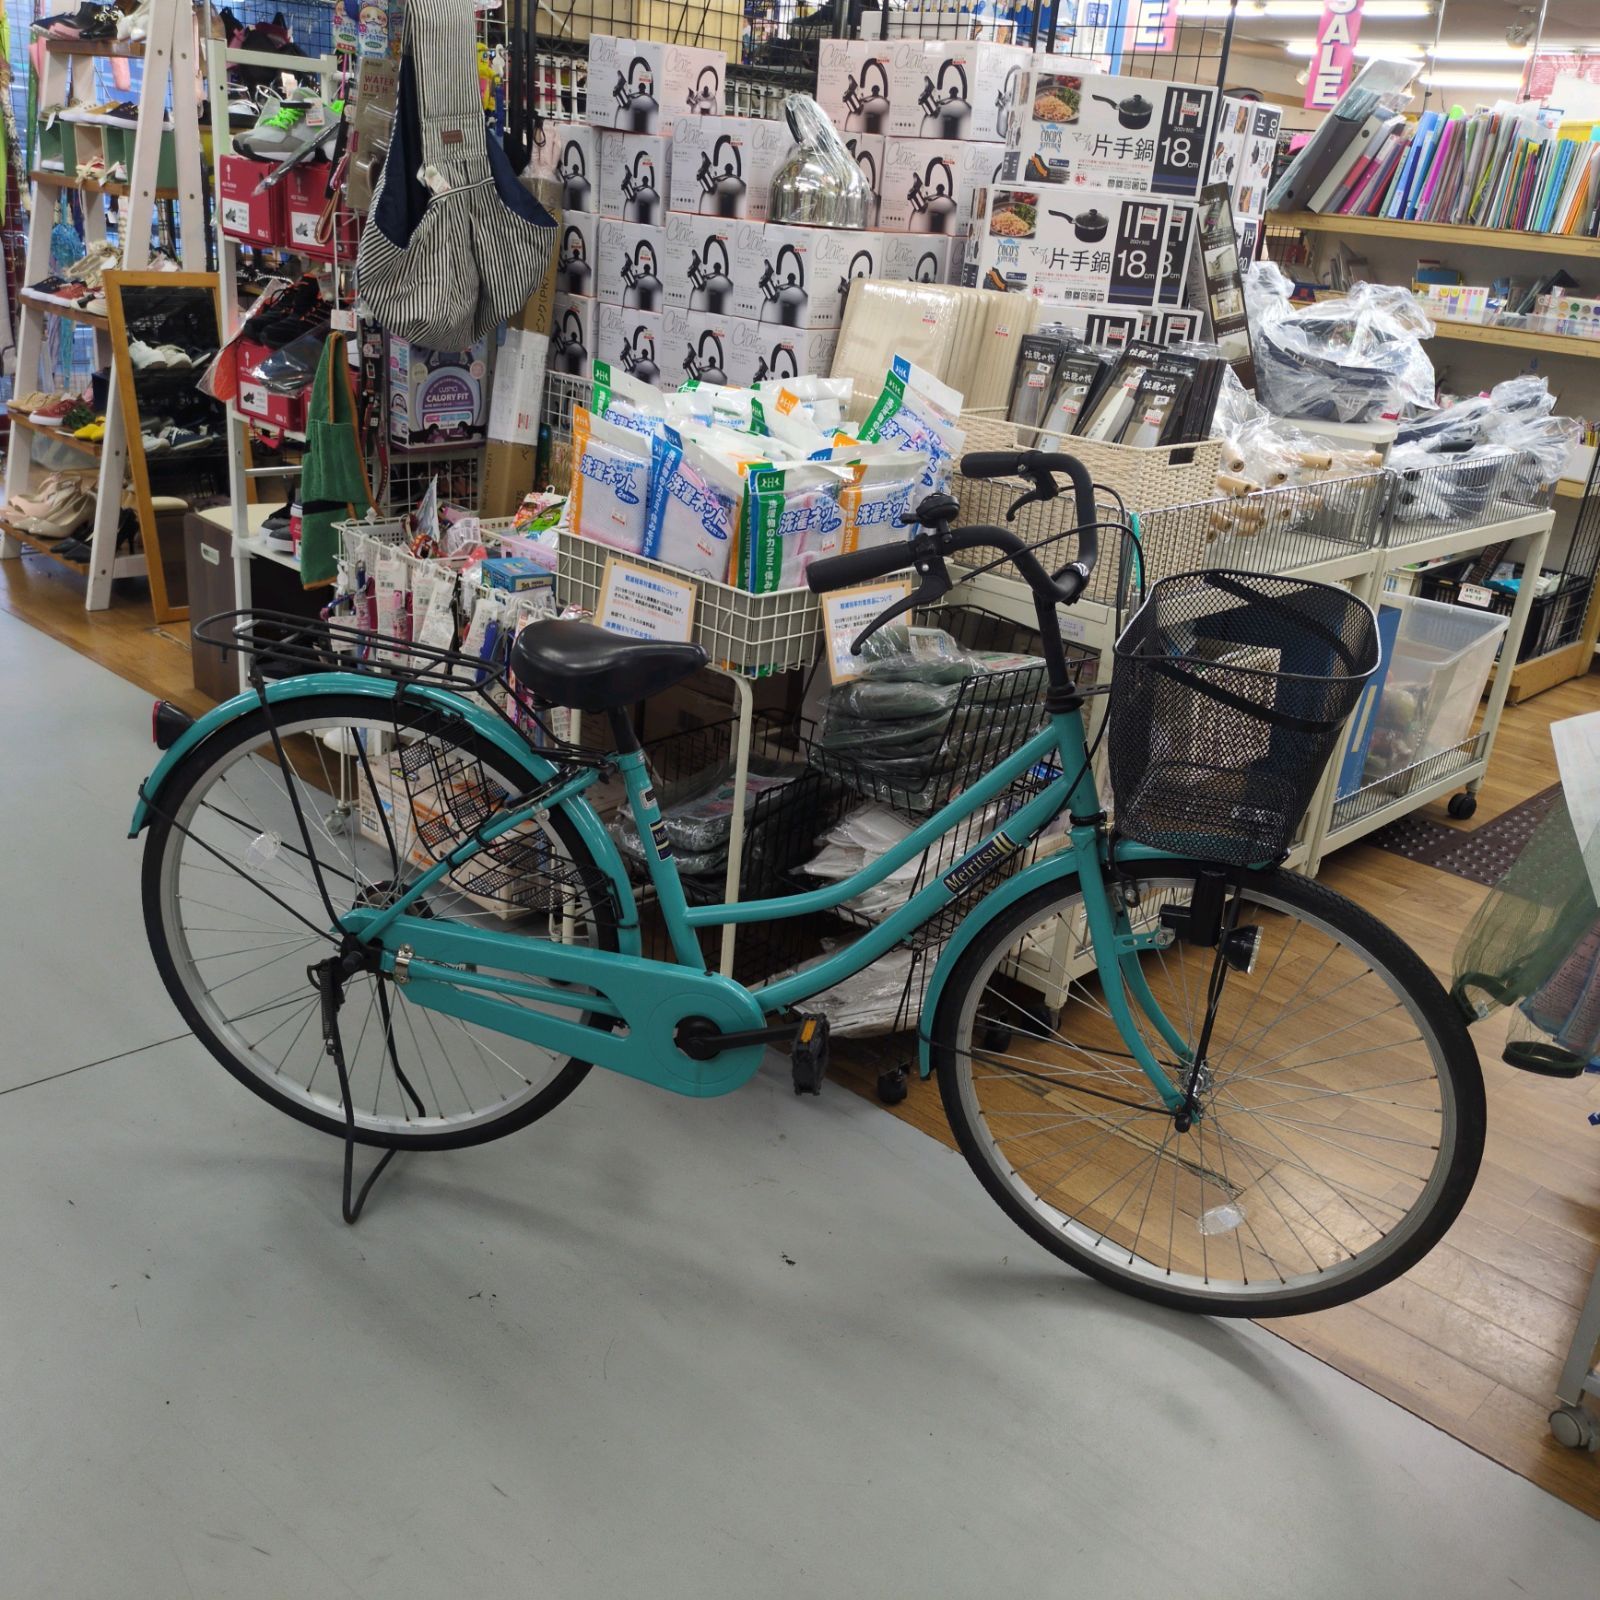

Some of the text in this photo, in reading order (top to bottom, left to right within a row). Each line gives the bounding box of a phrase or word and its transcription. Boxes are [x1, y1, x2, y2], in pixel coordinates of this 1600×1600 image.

[363, 83, 389, 93] DISH
[365, 74, 394, 87] WATER
[1168, 91, 1206, 128] IH
[1092, 133, 1155, 163] 片手鍋
[1124, 205, 1161, 241] IH
[1049, 247, 1112, 274] 片手鍋
[426, 392, 470, 403] CALORY FIT
[580, 453, 637, 493] 洗濯ネット
[666, 472, 728, 526] 洗濯ネット
[855, 498, 911, 527] 洗濯ネット
[777, 502, 840, 537] 洗濯ネット
